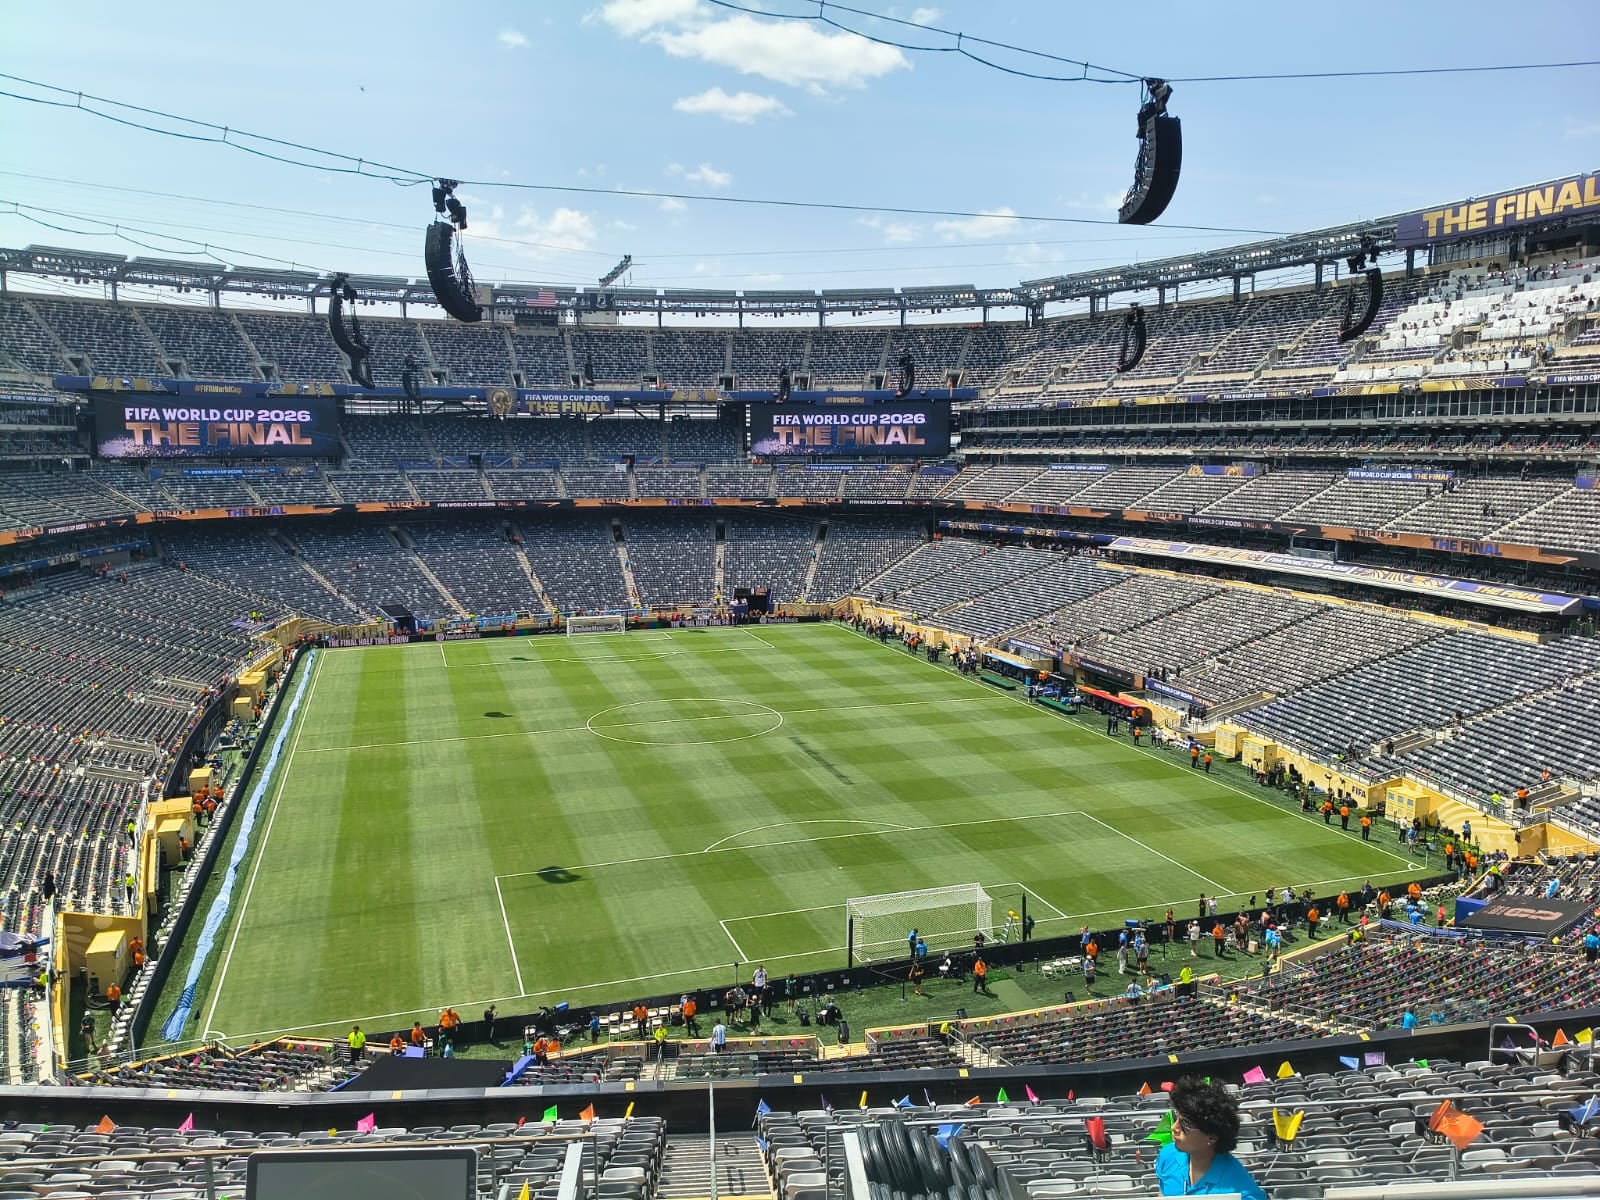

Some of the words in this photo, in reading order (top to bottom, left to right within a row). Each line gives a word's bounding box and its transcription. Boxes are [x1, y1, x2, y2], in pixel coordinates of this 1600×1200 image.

[1422, 201, 1489, 238] THE
[1494, 176, 1600, 225] FINAL
[194, 385, 242, 395] #FIFAWorldCup
[526, 401, 560, 412] THE
[562, 402, 610, 412] FINAL
[124, 408, 160, 421] FIFA
[162, 408, 220, 421] WORLD
[224, 409, 254, 422] CUP
[257, 410, 311, 422] 2026
[773, 415, 800, 424] FIFA
[802, 415, 849, 424] WORLD
[852, 414, 876, 424] CUP
[879, 414, 926, 424] 2026
[126, 422, 200, 446] THE
[207, 424, 312, 446] FINAL
[773, 426, 831, 446] THE
[837, 426, 925, 446] FINAL
[225, 508, 249, 517] THE
[252, 506, 287, 516] FINAL
[1430, 538, 1458, 551] THE
[1461, 540, 1503, 556] FINAL
[1474, 585, 1500, 596] THE
[1500, 590, 1544, 602] FINAL
[359, 638, 373, 646] HALF
[1352, 786, 1366, 798] FIFA
